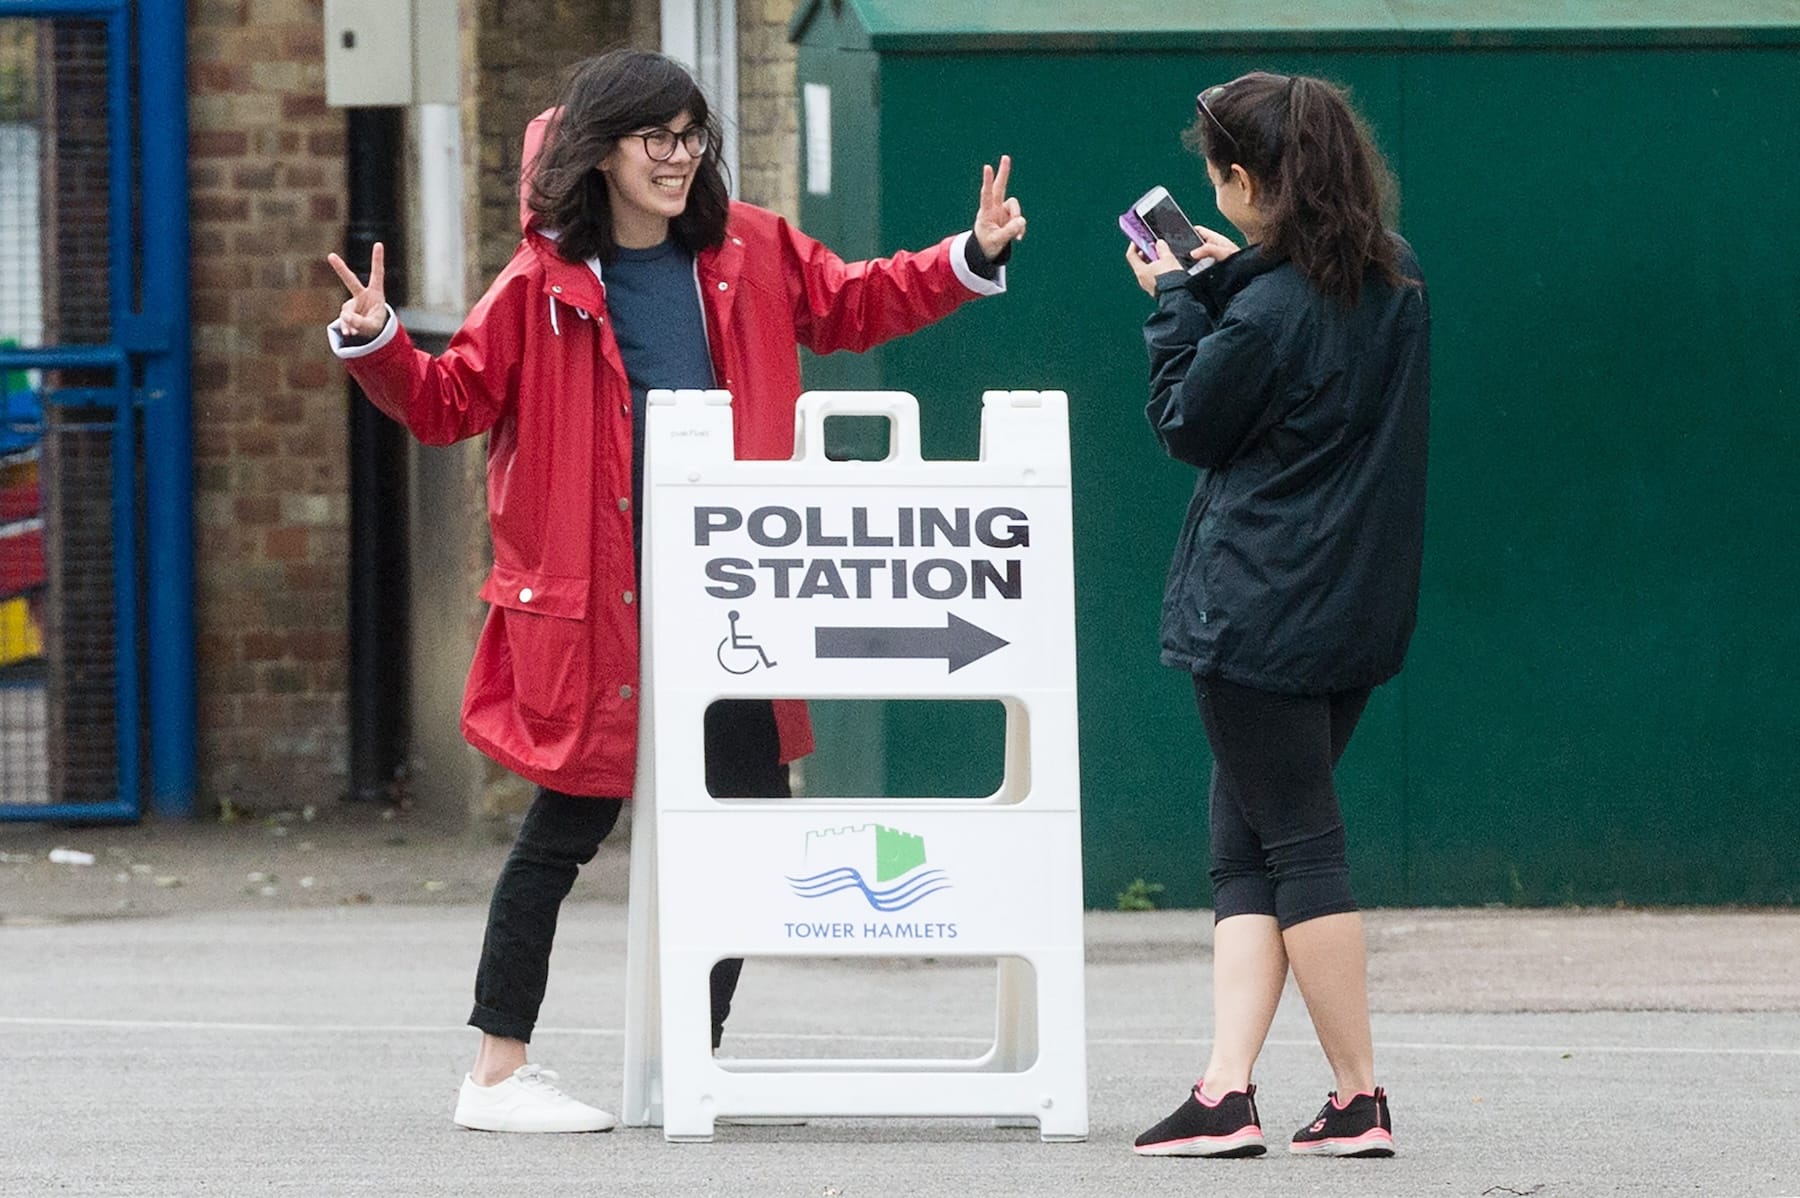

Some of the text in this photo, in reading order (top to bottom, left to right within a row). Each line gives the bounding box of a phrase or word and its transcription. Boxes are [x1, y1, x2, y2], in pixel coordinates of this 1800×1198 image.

[694, 506, 1030, 548] POLLING
[705, 558, 1022, 600] STATION
[784, 922, 958, 939] TOWER HAMLETS
